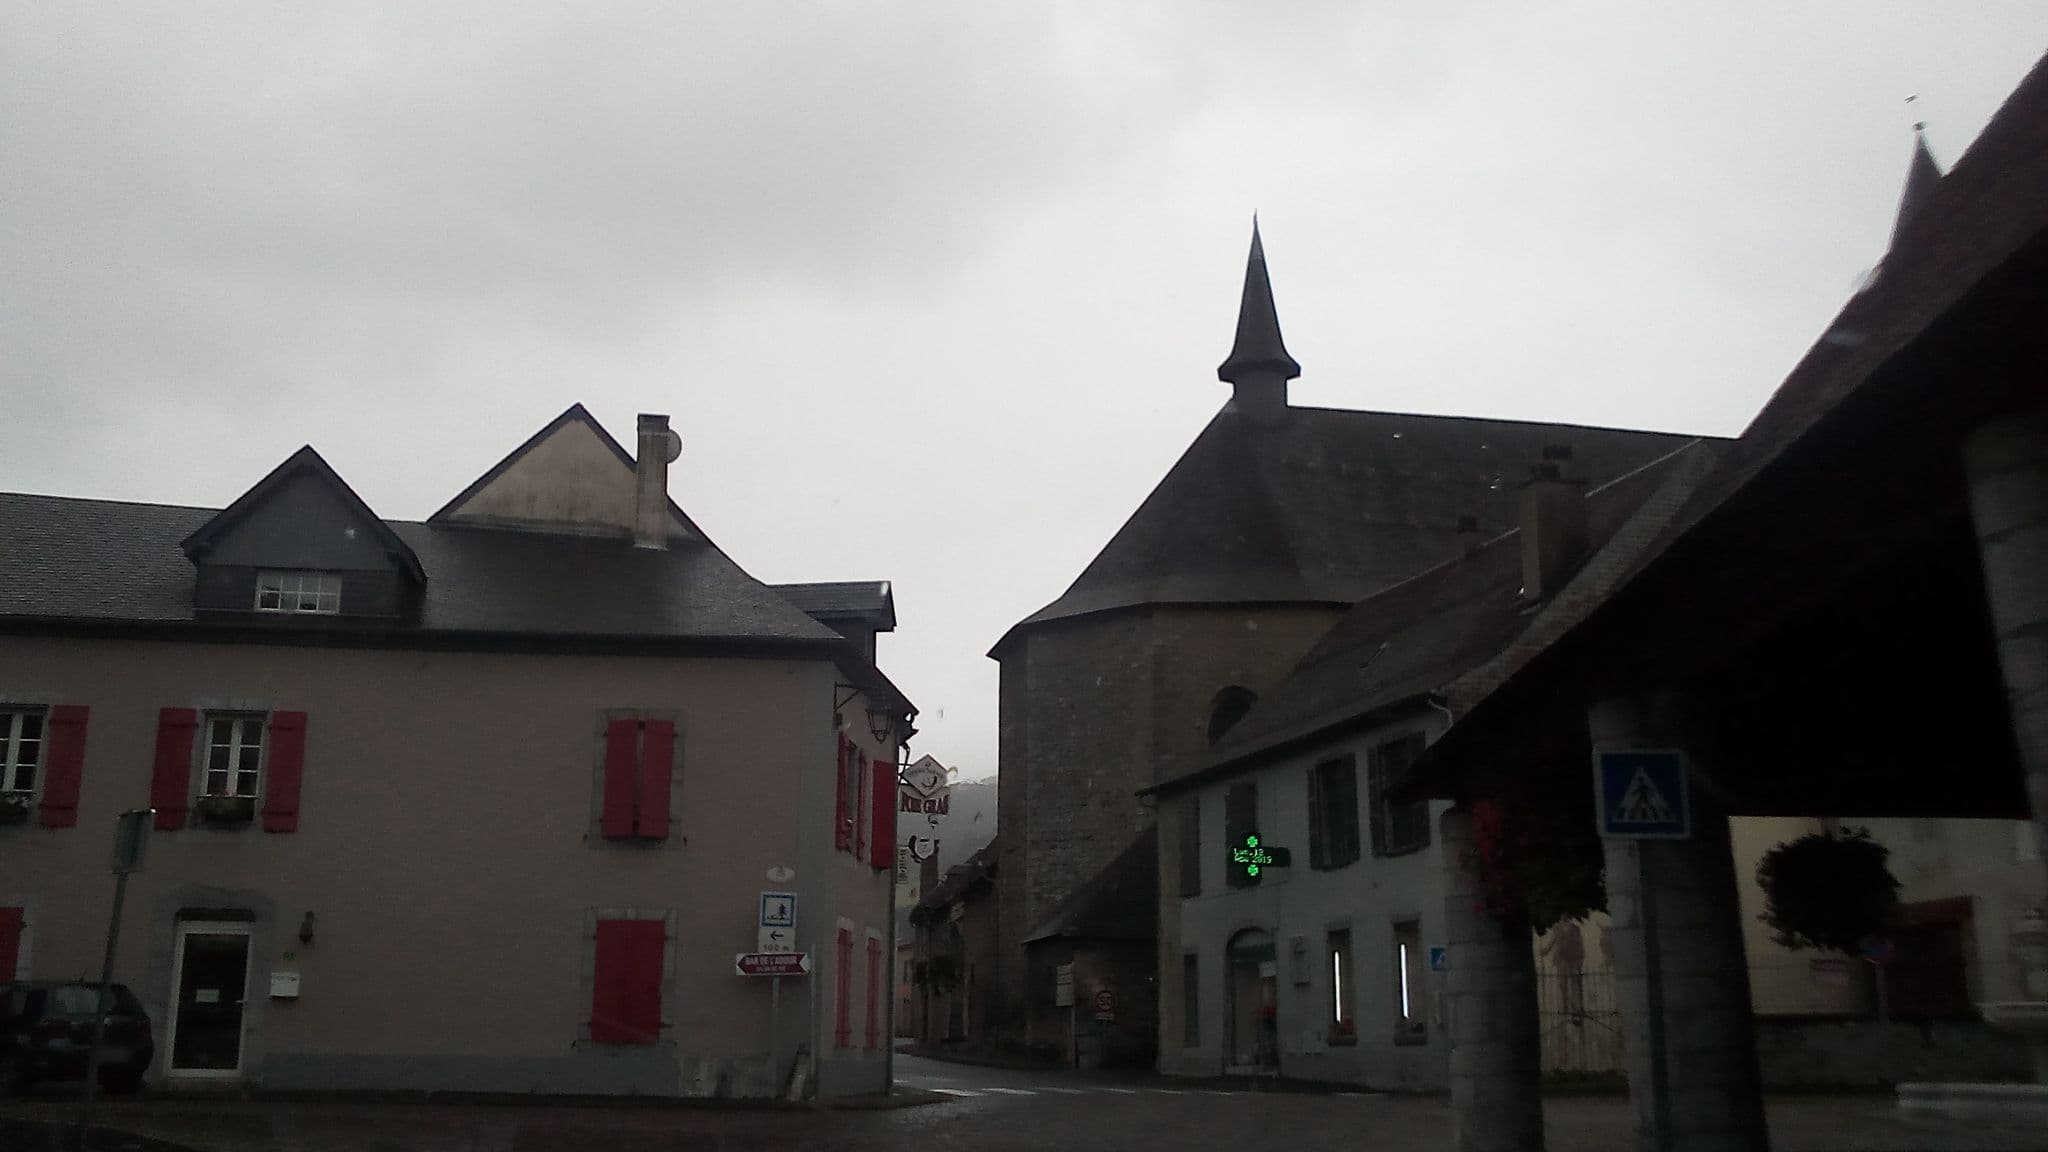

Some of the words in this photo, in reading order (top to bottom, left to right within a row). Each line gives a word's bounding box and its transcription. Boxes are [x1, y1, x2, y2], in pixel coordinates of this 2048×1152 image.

[763, 944, 780, 952] 100
[745, 956, 759, 966] BAR
[760, 956, 769, 966] DE
